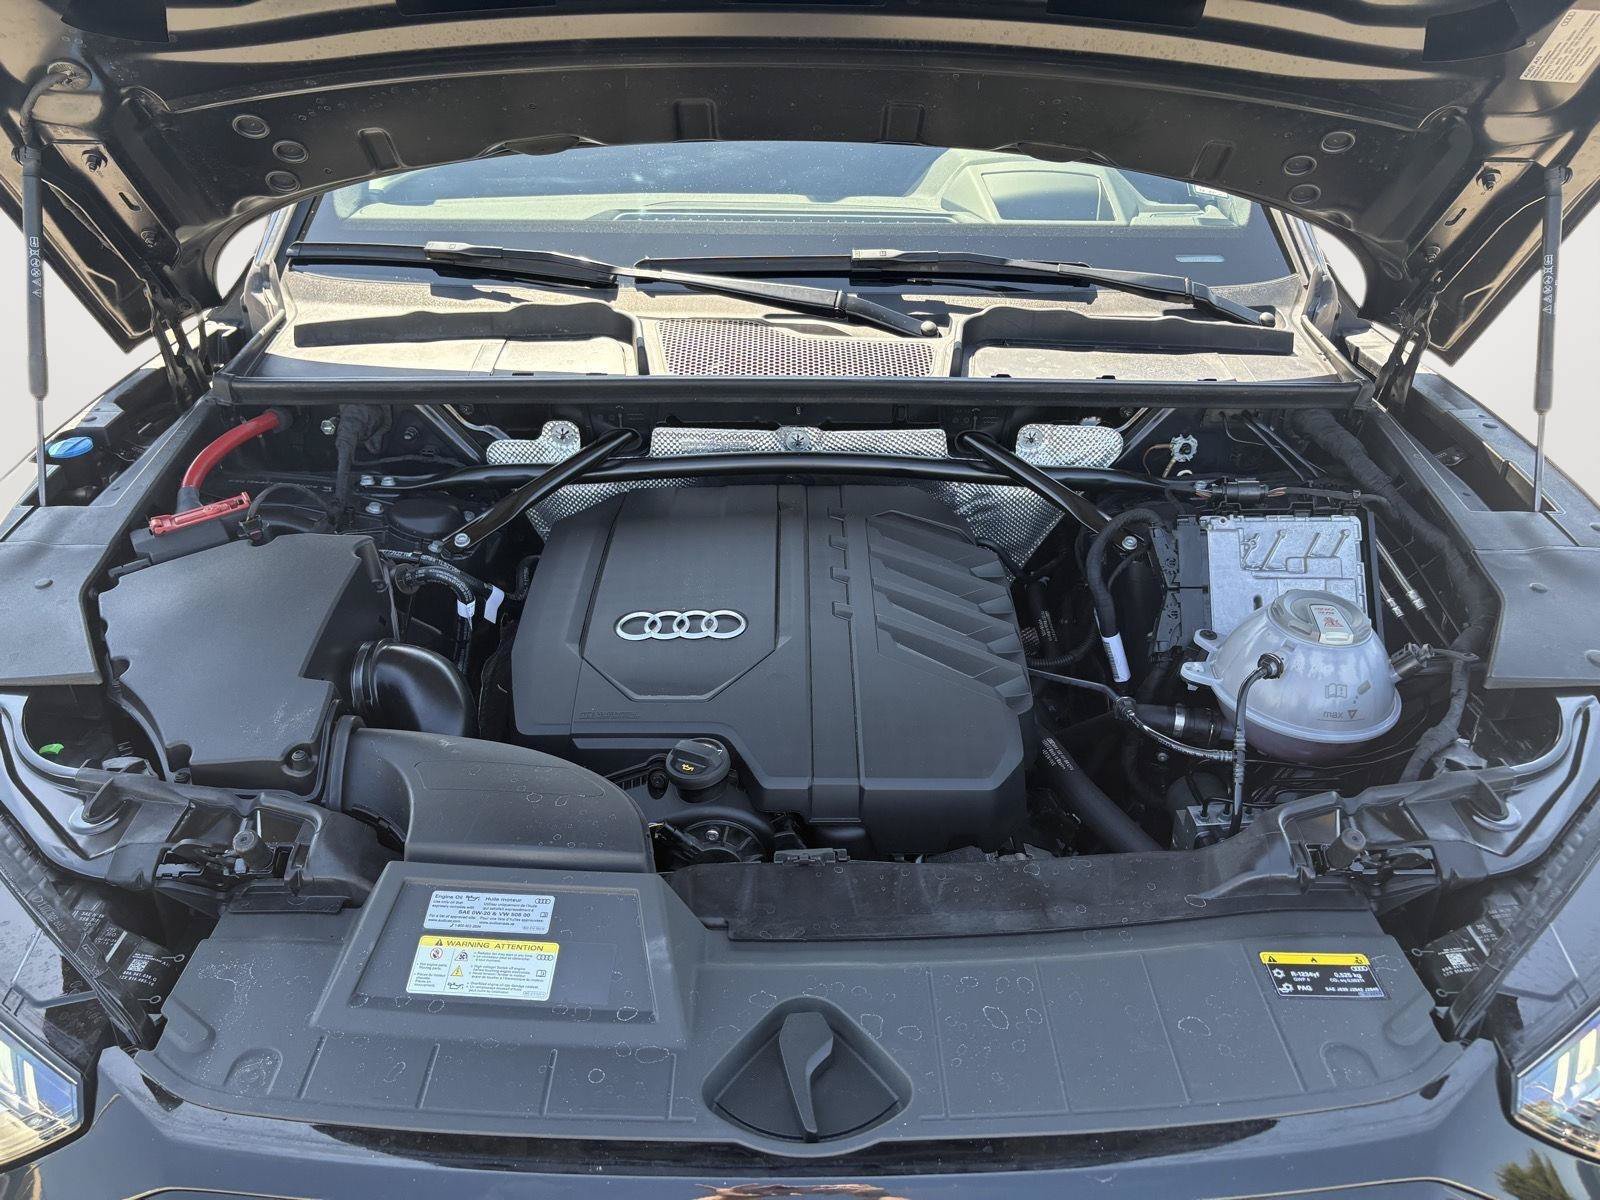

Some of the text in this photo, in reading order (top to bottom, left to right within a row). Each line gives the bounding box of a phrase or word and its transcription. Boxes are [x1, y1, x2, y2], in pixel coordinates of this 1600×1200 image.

[1323, 710, 1343, 719] max
[445, 940, 544, 951] WARNING ATTENTION
